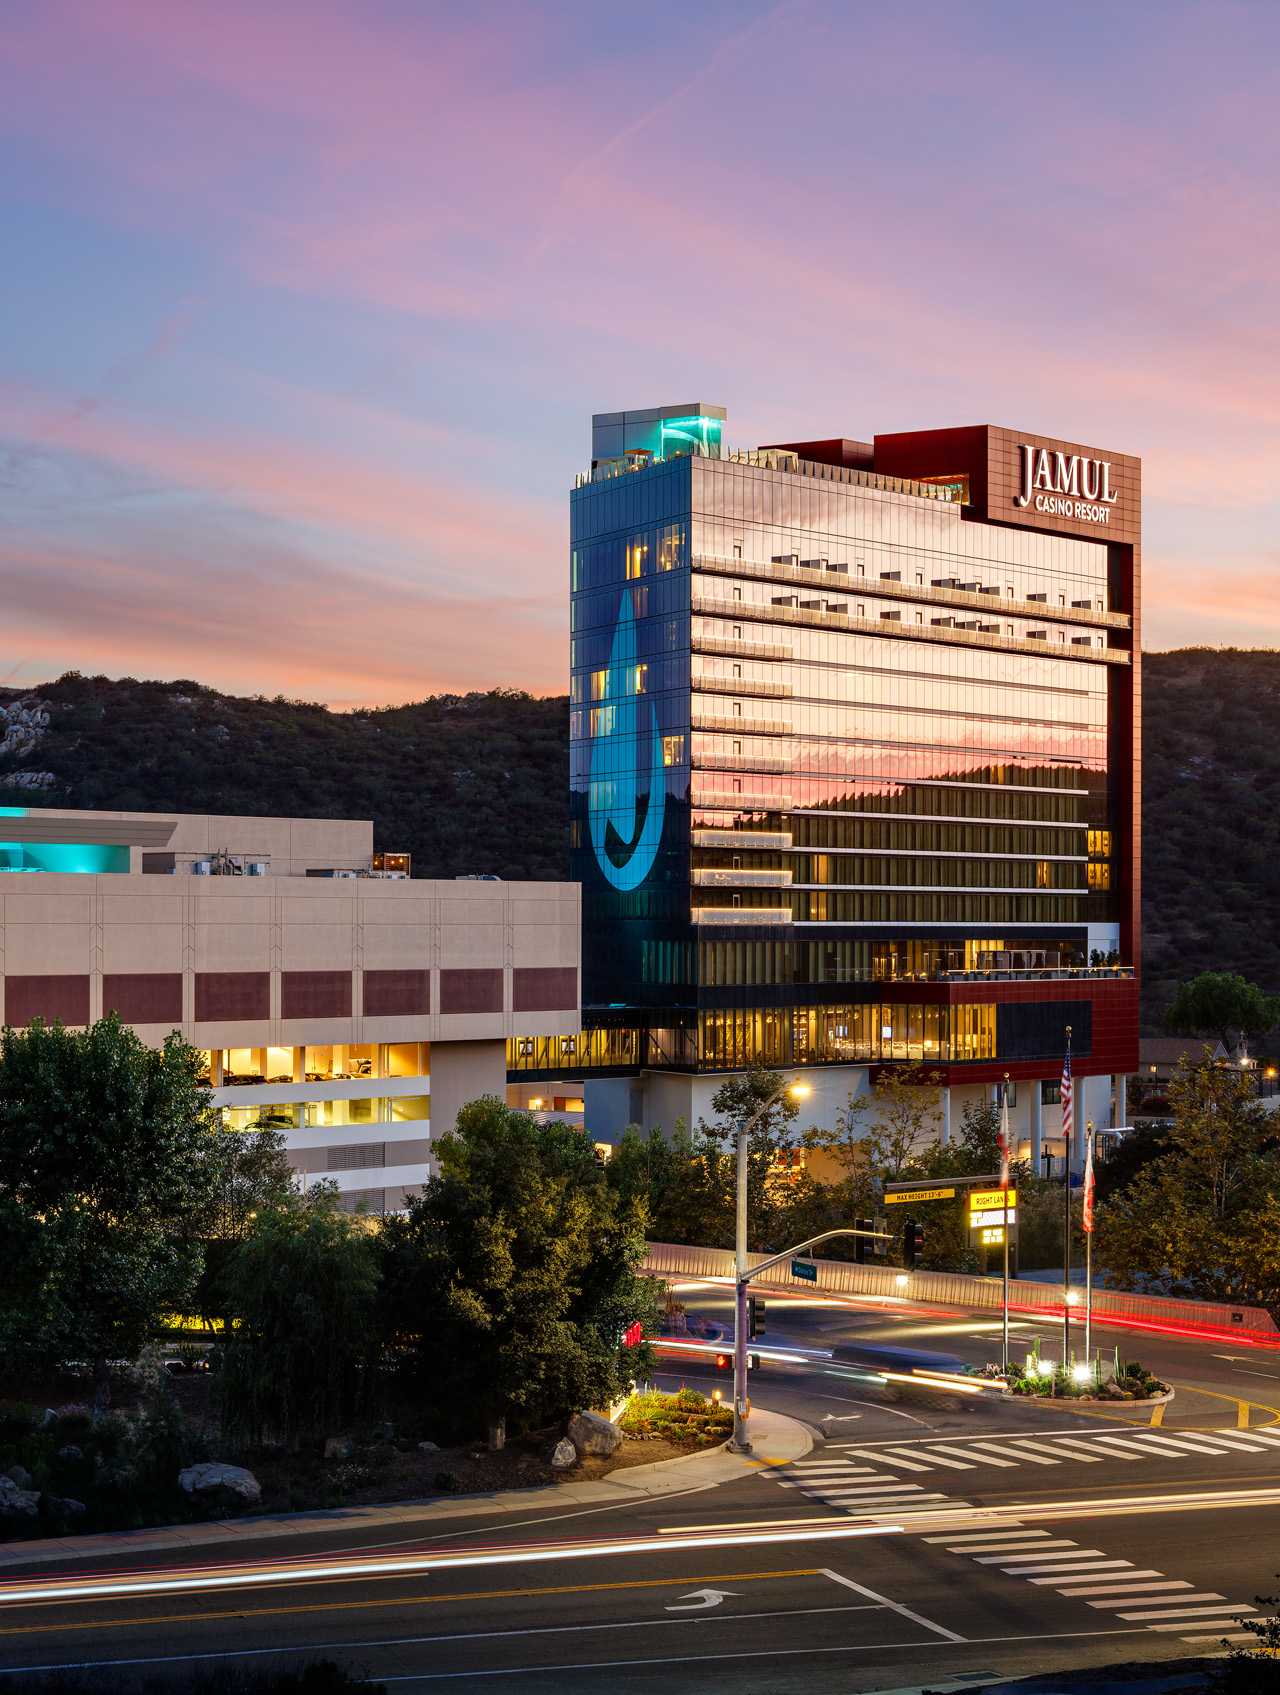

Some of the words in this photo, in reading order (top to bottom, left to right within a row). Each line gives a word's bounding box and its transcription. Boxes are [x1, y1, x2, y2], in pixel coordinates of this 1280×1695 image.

[1016, 444, 1117, 507] JAMUL
[1035, 495, 1073, 517] CASINO
[1074, 501, 1111, 524] RESORT
[908, 1192, 928, 1200] HEIGHT
[976, 1196, 993, 1205] RIGHT
